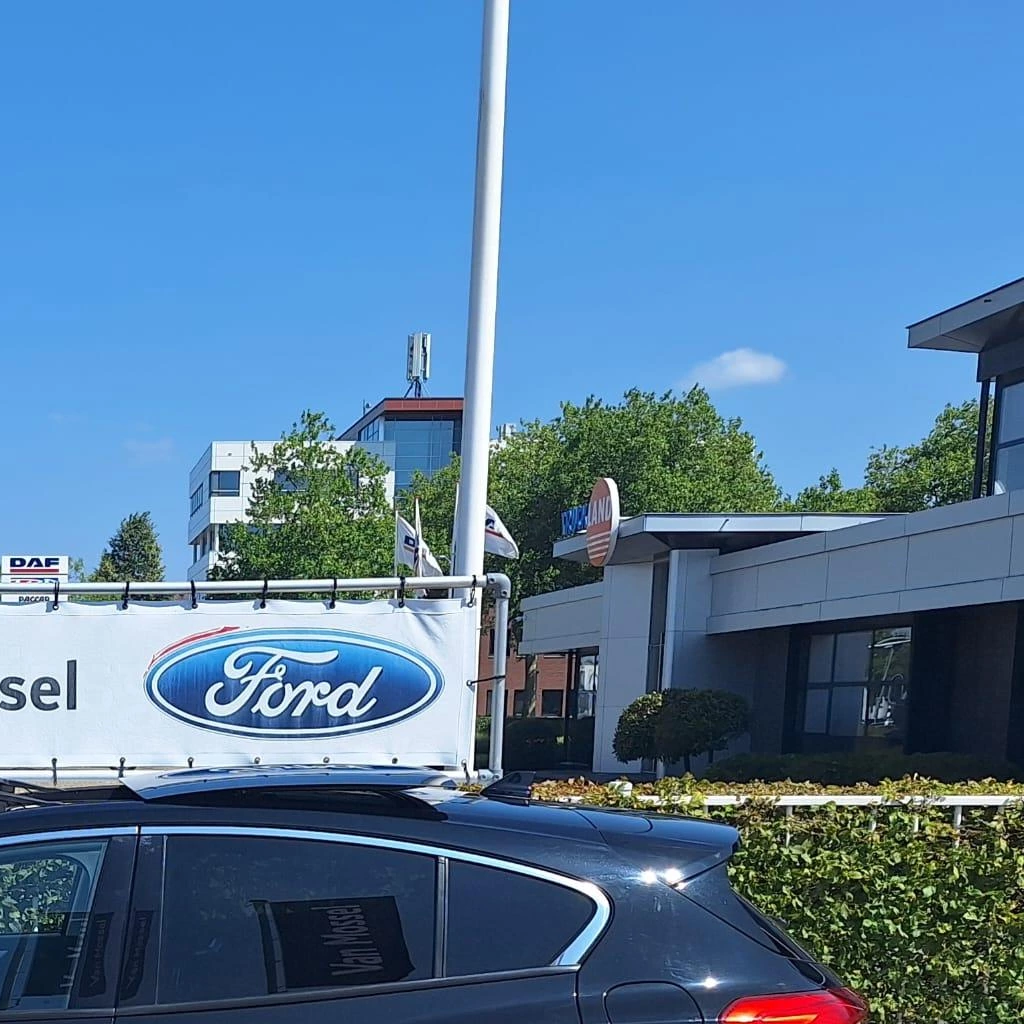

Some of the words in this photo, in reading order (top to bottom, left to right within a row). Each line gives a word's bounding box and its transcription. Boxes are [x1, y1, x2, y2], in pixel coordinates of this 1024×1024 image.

[9, 557, 60, 568] DAF
[204, 646, 383, 718] Ford
[311, 904, 374, 945] Mossel
[329, 948, 384, 976] Van
